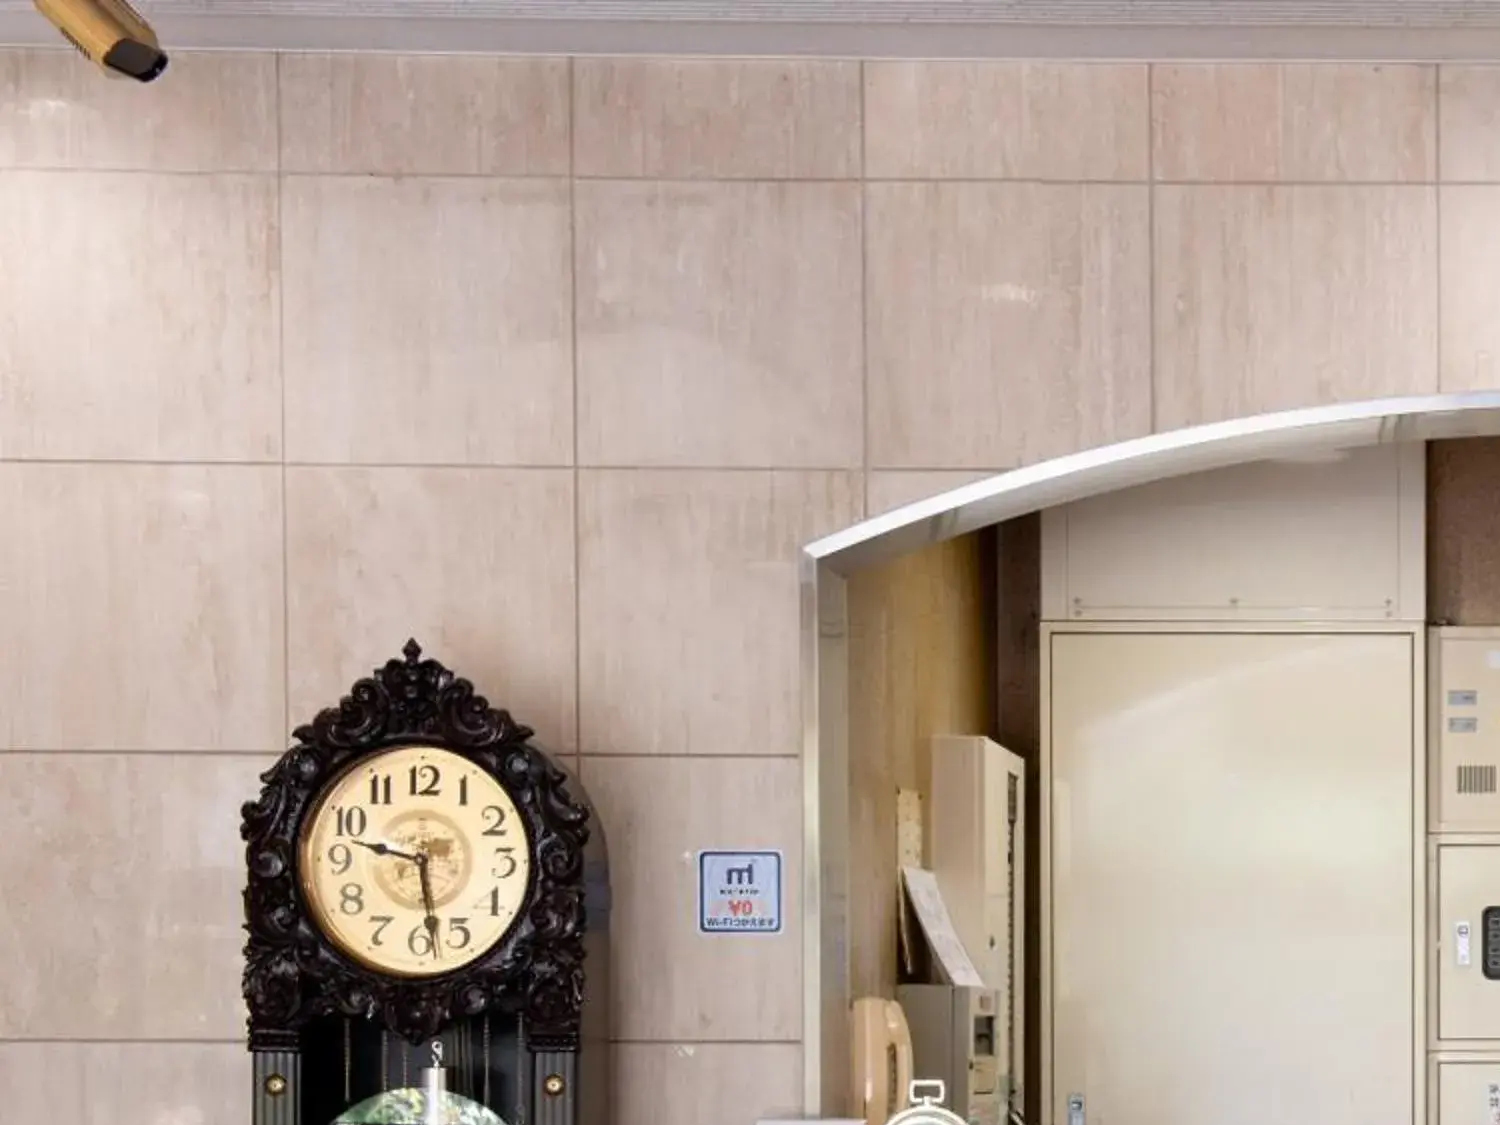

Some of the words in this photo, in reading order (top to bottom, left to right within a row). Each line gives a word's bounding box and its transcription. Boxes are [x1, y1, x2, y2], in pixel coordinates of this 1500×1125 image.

[369, 774, 392, 805] 11
[408, 764, 441, 797] 12
[458, 774, 468, 806] 1
[335, 805, 366, 837] 10
[481, 805, 507, 837] 2
[327, 844, 352, 876] 9
[492, 847, 517, 879] 3
[340, 883, 365, 915] 8
[473, 886, 504, 917] 4
[368, 916, 395, 947] 7
[407, 924, 432, 956] 6
[446, 917, 471, 949] 5
